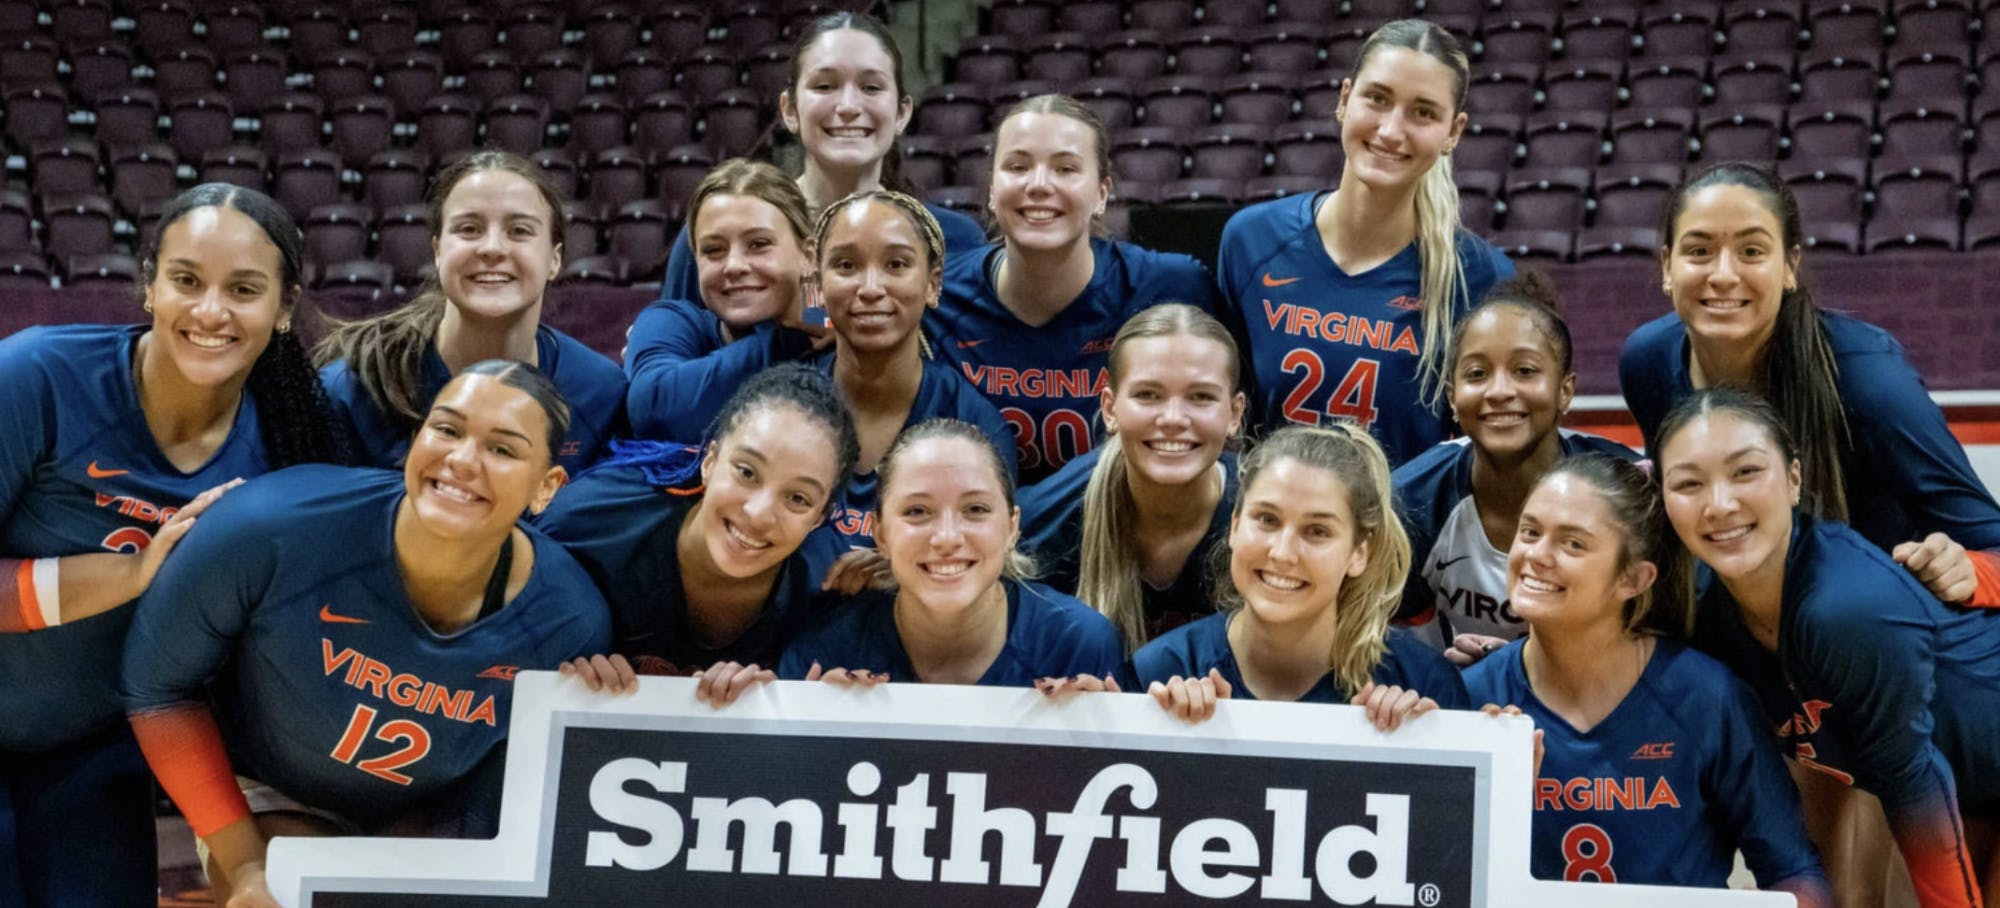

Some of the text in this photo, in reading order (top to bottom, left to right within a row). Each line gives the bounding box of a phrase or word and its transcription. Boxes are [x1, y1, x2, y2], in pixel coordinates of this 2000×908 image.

[1263, 298, 1420, 356] VIRGINIA
[961, 361, 1110, 398] VIRGINIA
[1281, 348, 1380, 434] 24
[999, 407, 1092, 469] 30
[322, 638, 496, 727] VIRGINIA
[330, 703, 431, 785] 12
[1631, 742, 1676, 760] ACC
[1561, 823, 1617, 883] 8
